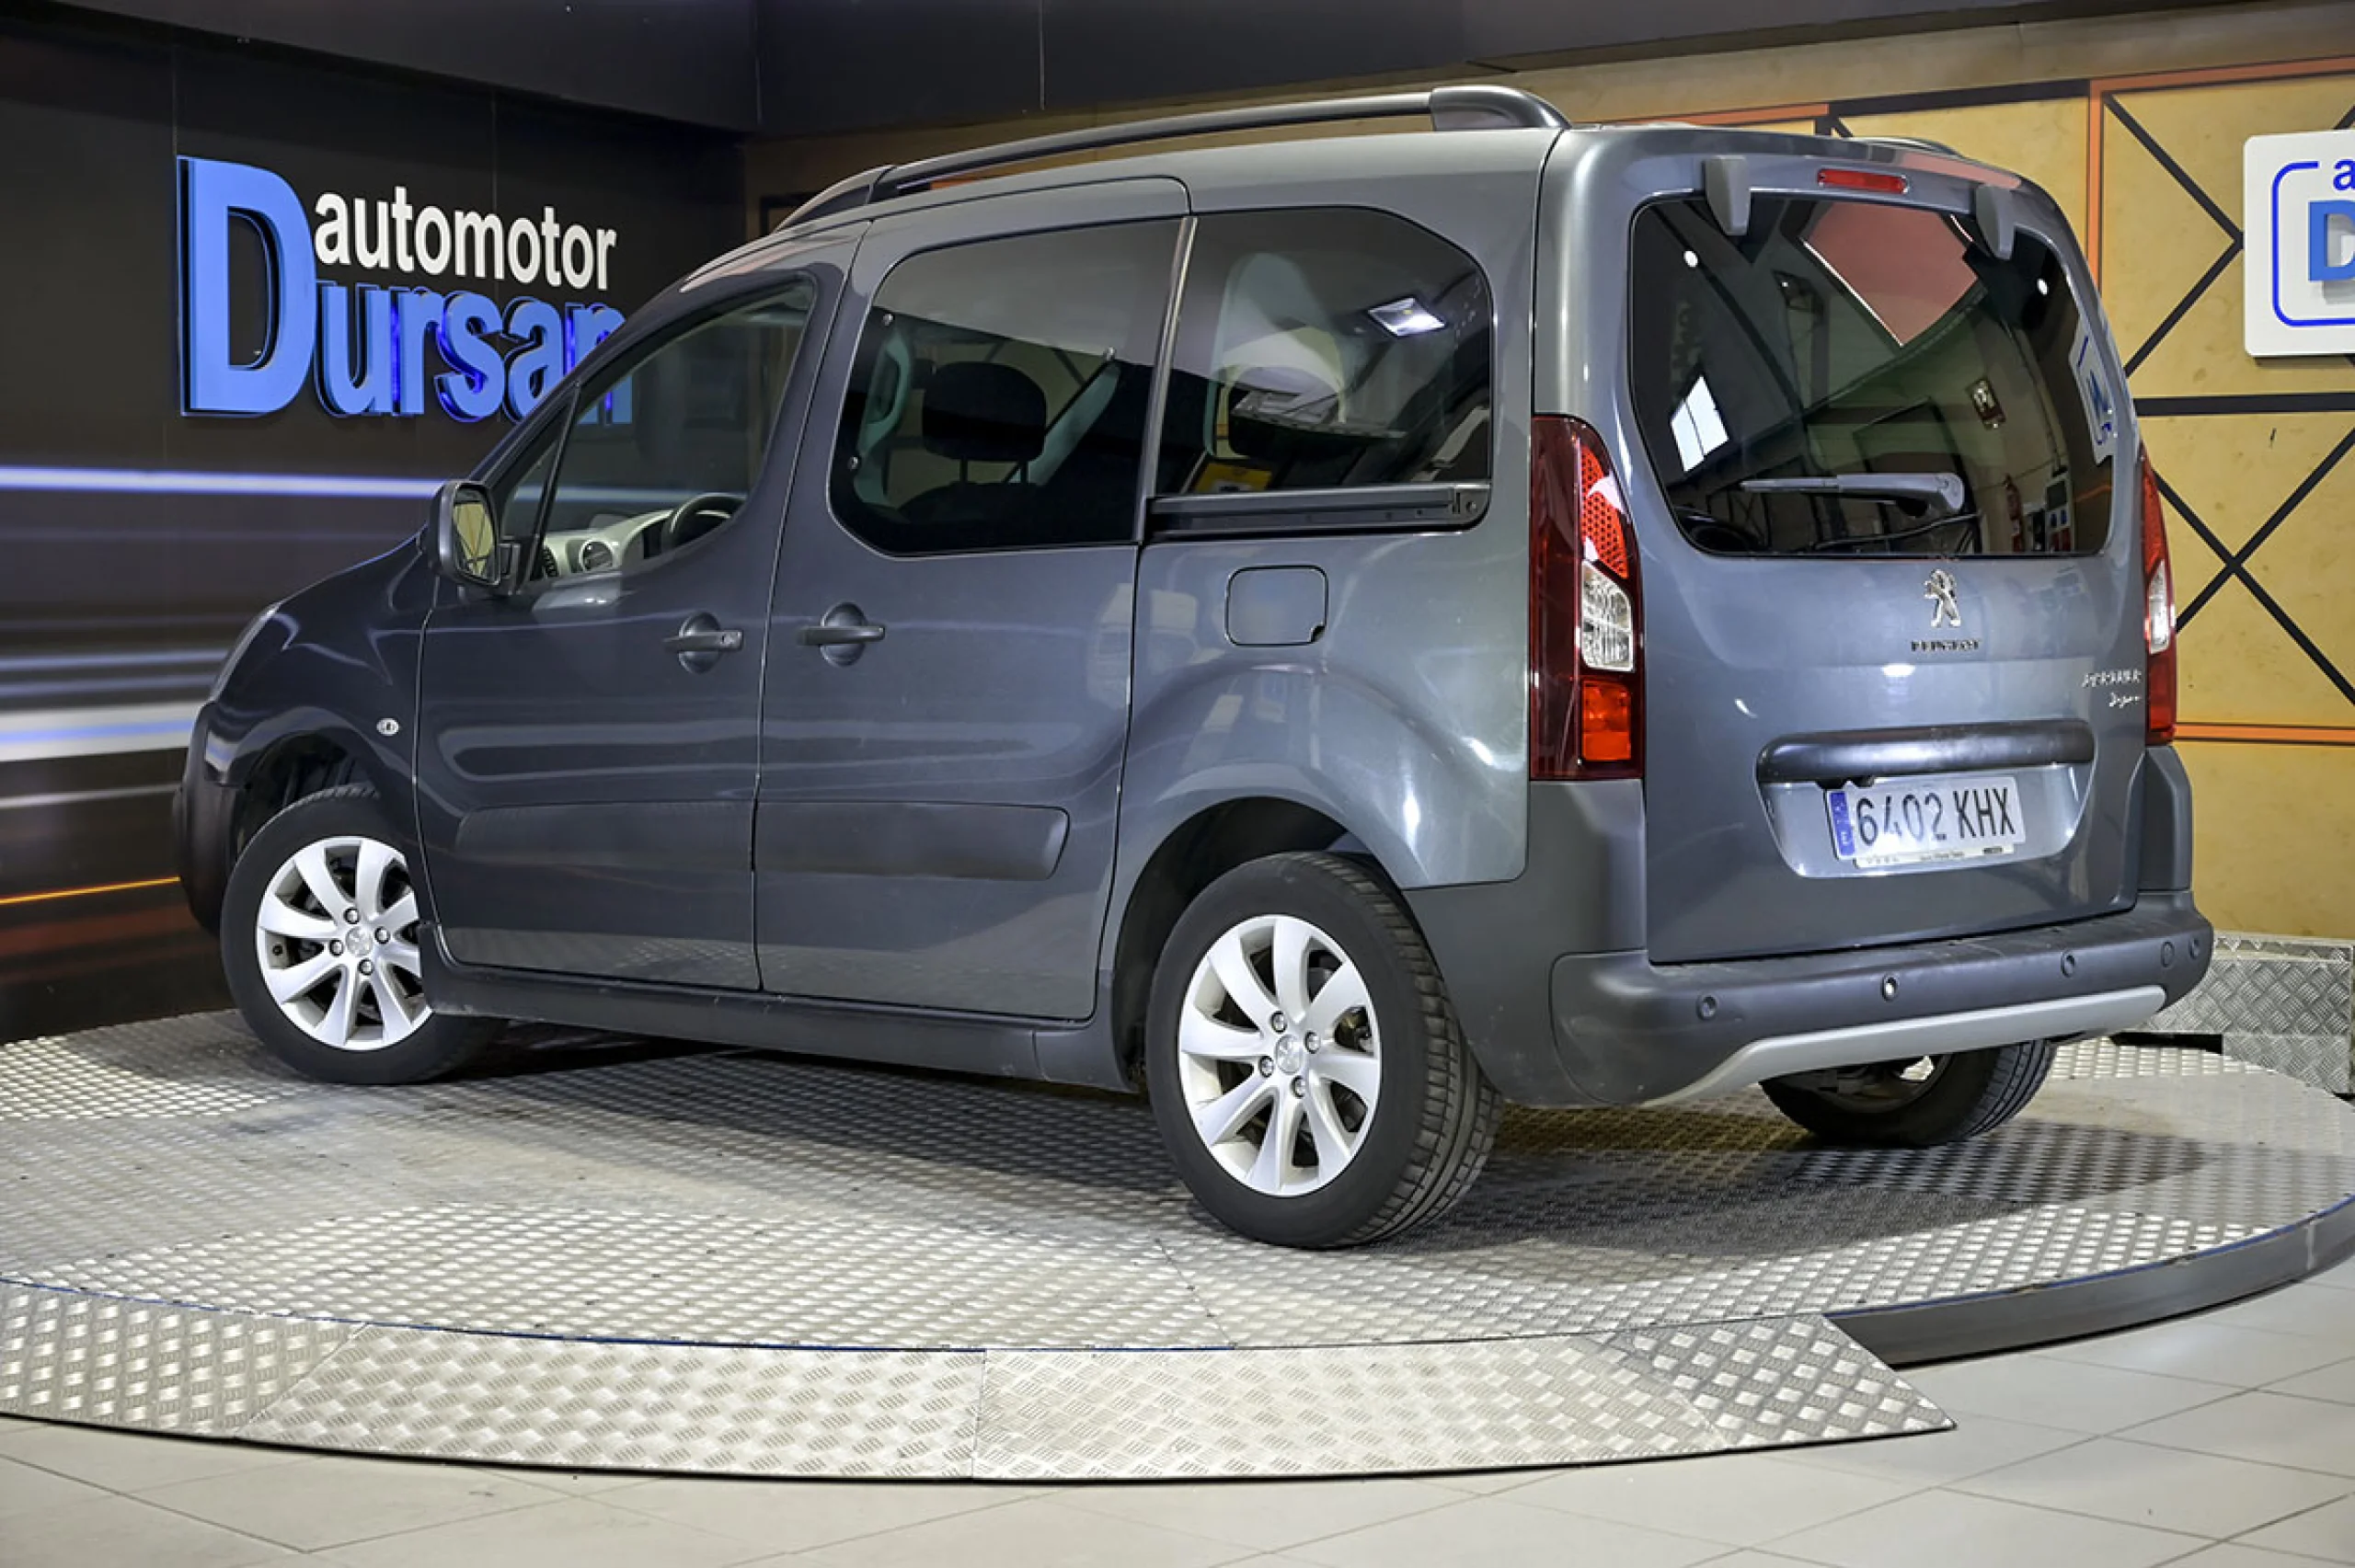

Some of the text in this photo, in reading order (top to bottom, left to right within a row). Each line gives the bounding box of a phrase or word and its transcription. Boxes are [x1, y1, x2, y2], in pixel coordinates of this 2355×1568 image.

[313, 186, 617, 290] automotor
[1856, 786, 2016, 846] 6402 KHX
